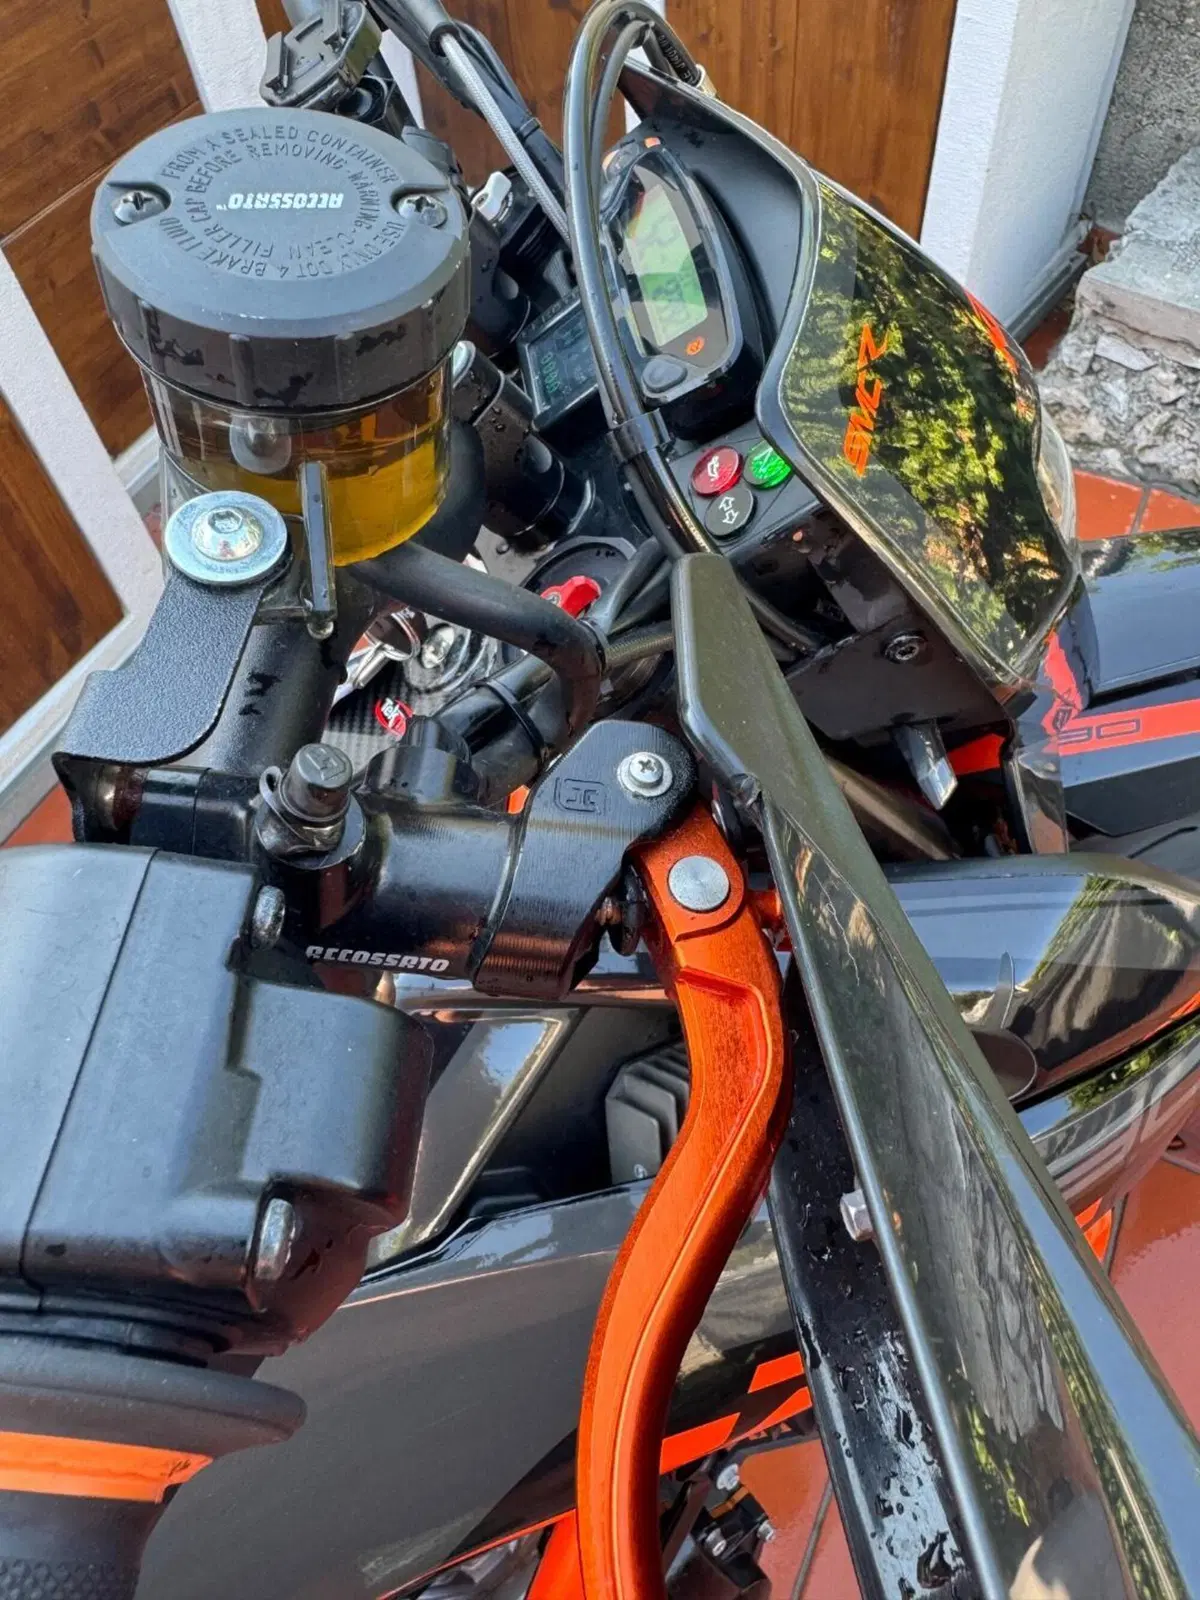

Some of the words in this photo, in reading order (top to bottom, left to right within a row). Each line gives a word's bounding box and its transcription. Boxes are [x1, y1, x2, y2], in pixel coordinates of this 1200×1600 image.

[205, 137, 222, 152] A
[221, 124, 299, 146] SEALED
[160, 145, 207, 180] FROM
[306, 128, 400, 183] CONTAINER
[185, 148, 242, 194] BEFORE
[184, 197, 212, 223] CAP
[159, 217, 204, 252] FLUID
[204, 223, 274, 258] FILLER
[373, 221, 406, 247] USE
[199, 248, 268, 277] BRAKE
[278, 265, 290, 278] 4
[297, 260, 333, 278] DOT
[305, 945, 450, 972] ACCOSSATO
